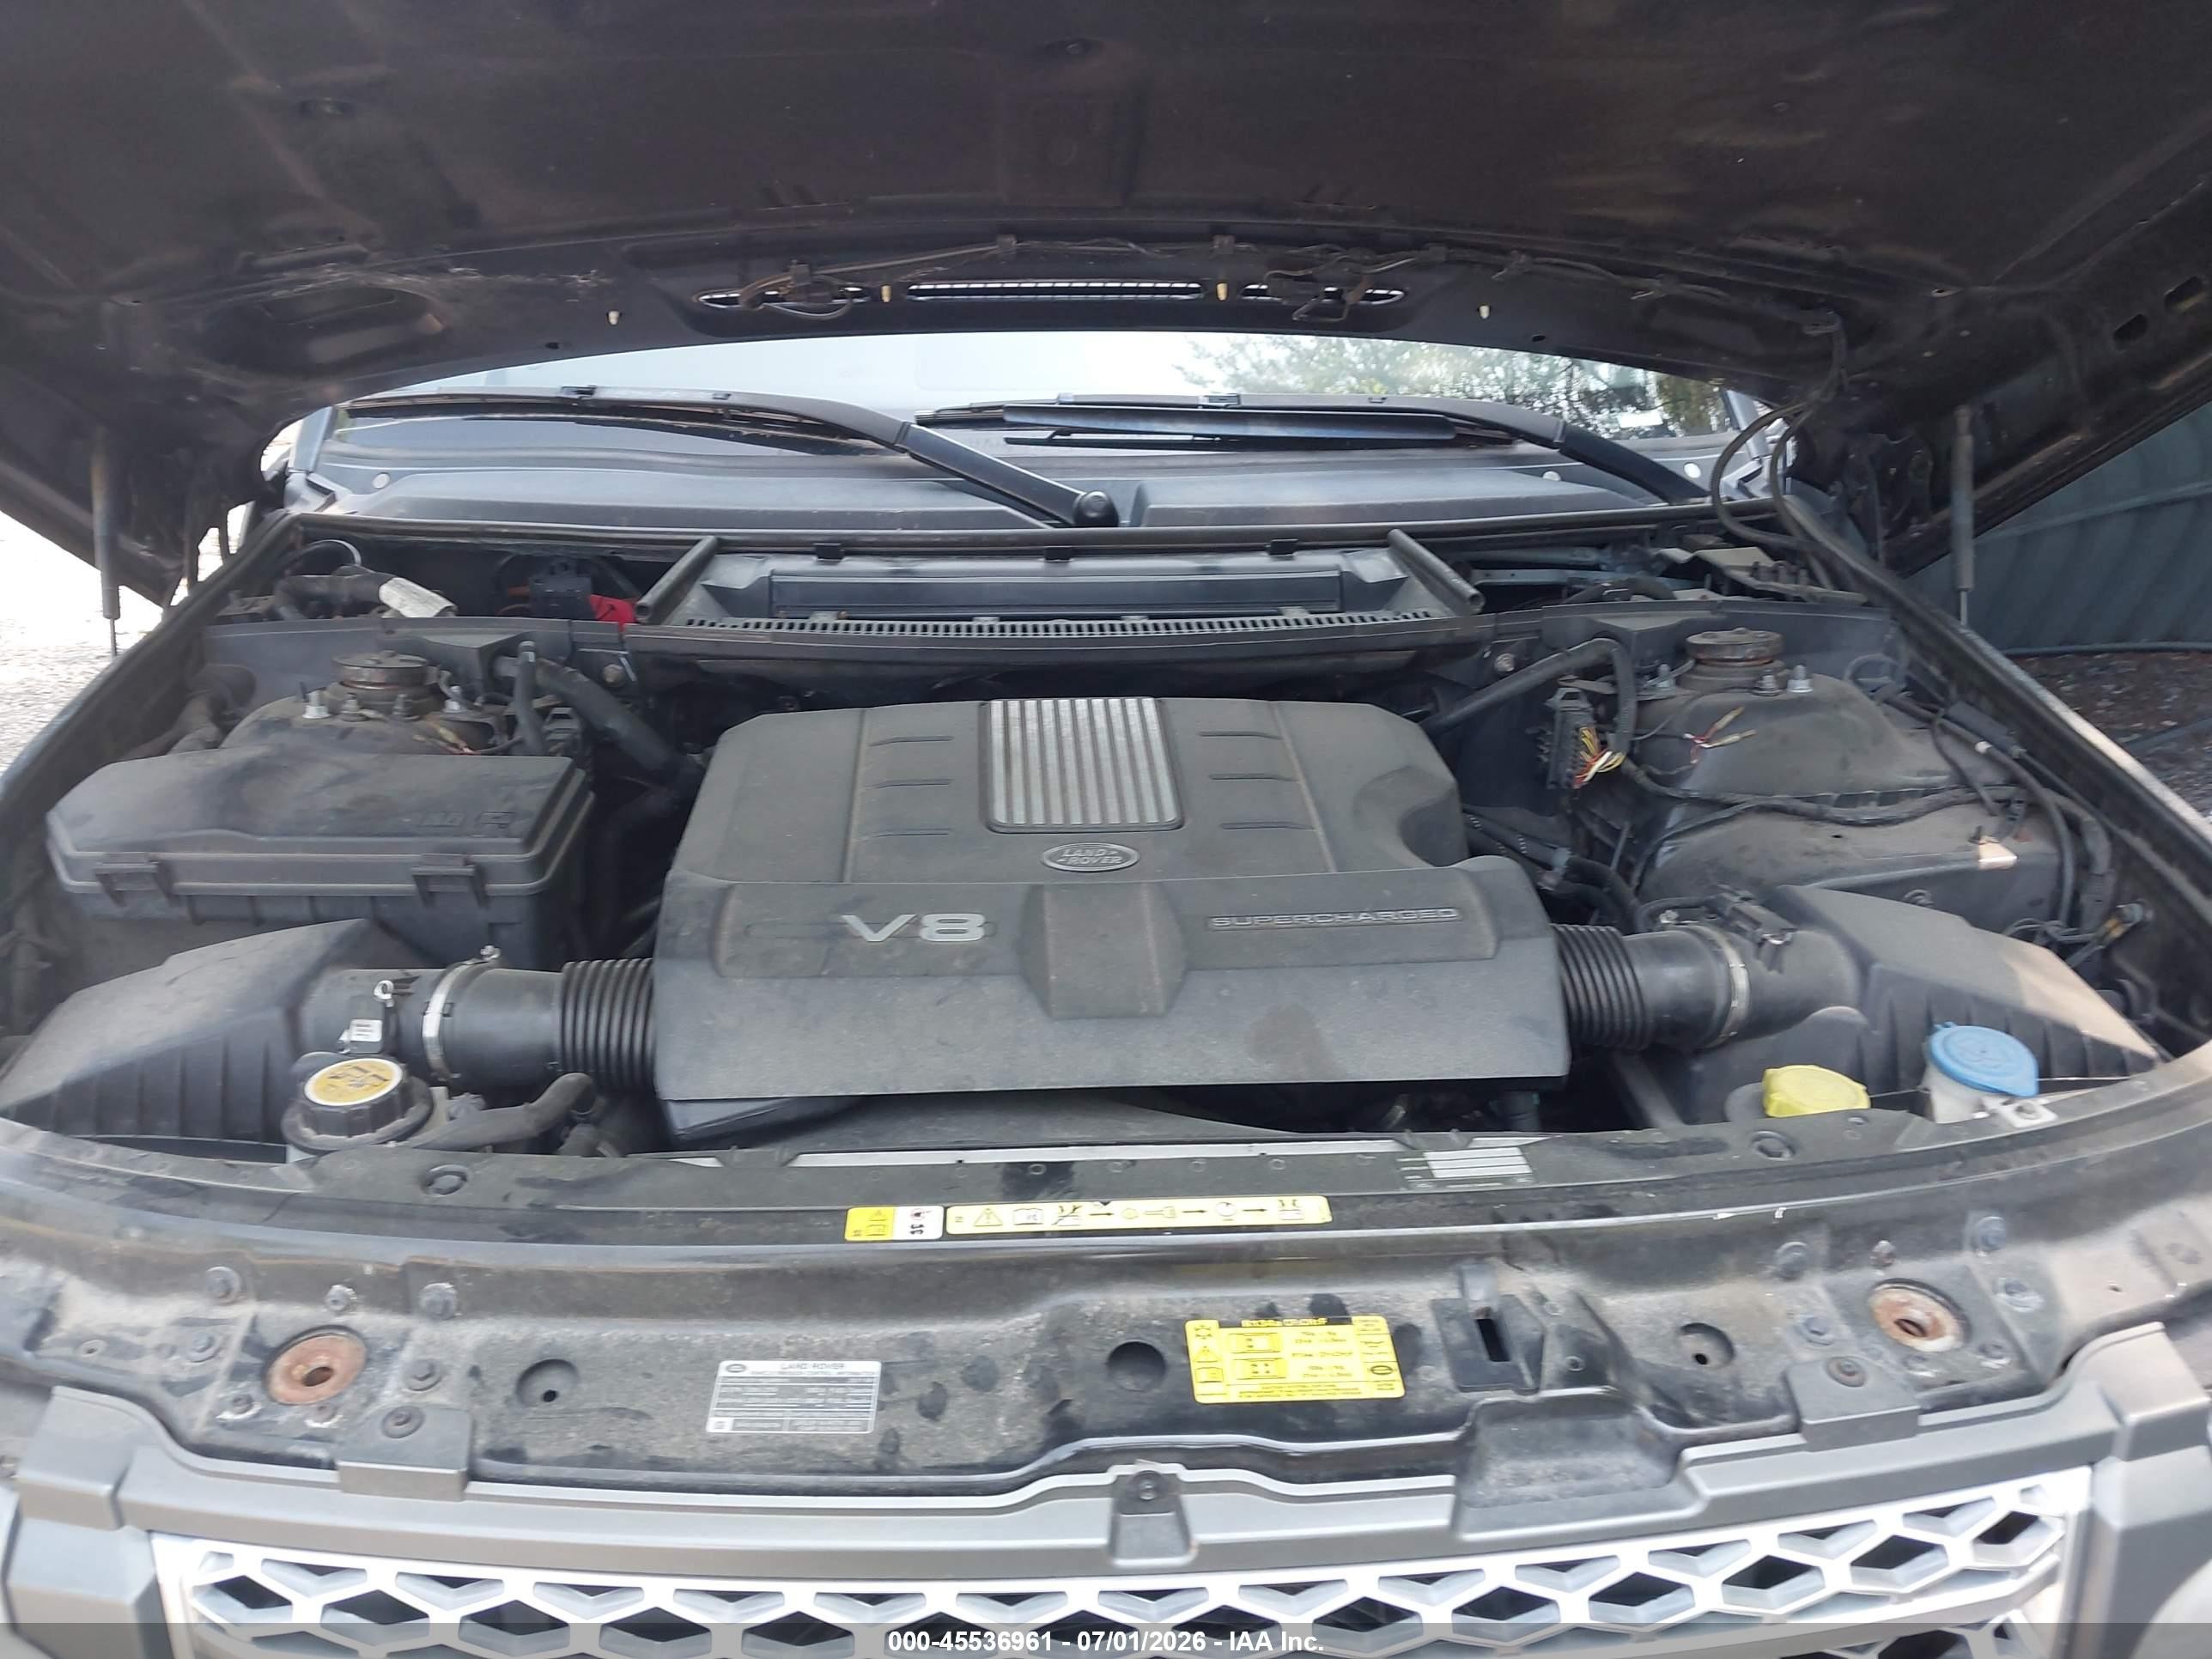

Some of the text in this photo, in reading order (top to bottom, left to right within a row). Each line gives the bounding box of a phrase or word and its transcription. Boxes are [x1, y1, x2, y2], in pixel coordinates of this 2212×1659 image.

[1061, 848, 1107, 857] LAND
[1066, 856, 1122, 865] ROVER
[1211, 908, 1458, 927] SUPERCHARGED
[841, 913, 986, 942] V8
